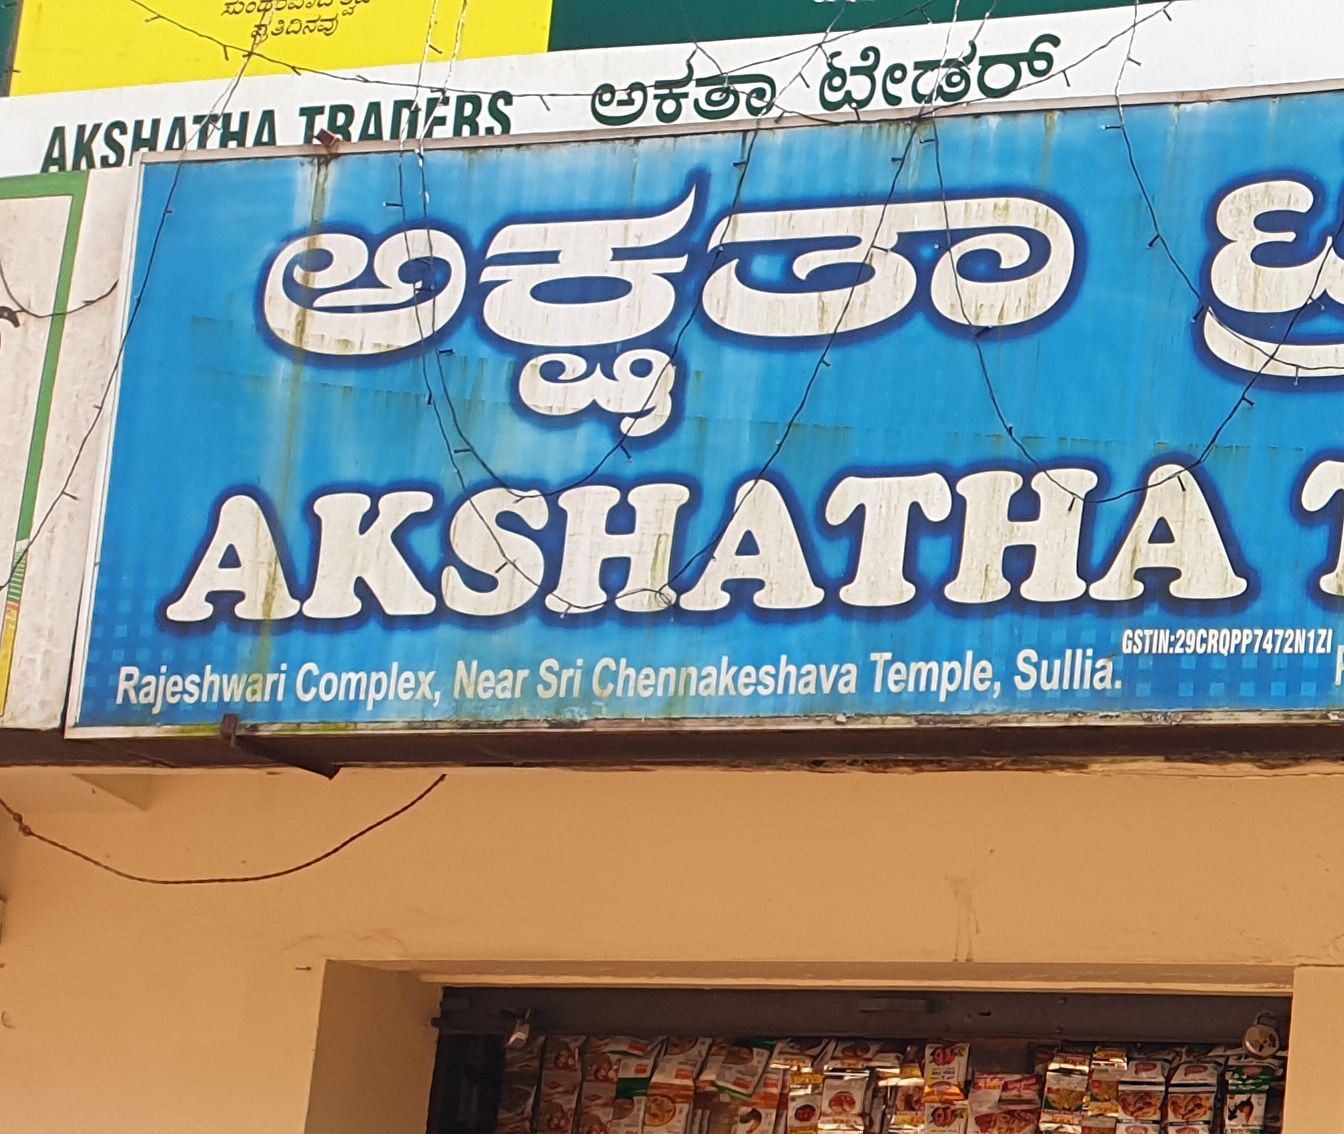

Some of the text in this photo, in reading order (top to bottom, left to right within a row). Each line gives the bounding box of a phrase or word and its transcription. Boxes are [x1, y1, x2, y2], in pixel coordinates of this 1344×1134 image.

[40, 90, 514, 173] AKSHATHA TRADERS
[264, 182, 1076, 438] ಅಕ್ಷತಾ
[163, 462, 1250, 623] AKSHATHA
[116, 648, 1124, 715] Rajeshwari Complex, Near Sri Chennakeshava Temple, Sullia.
